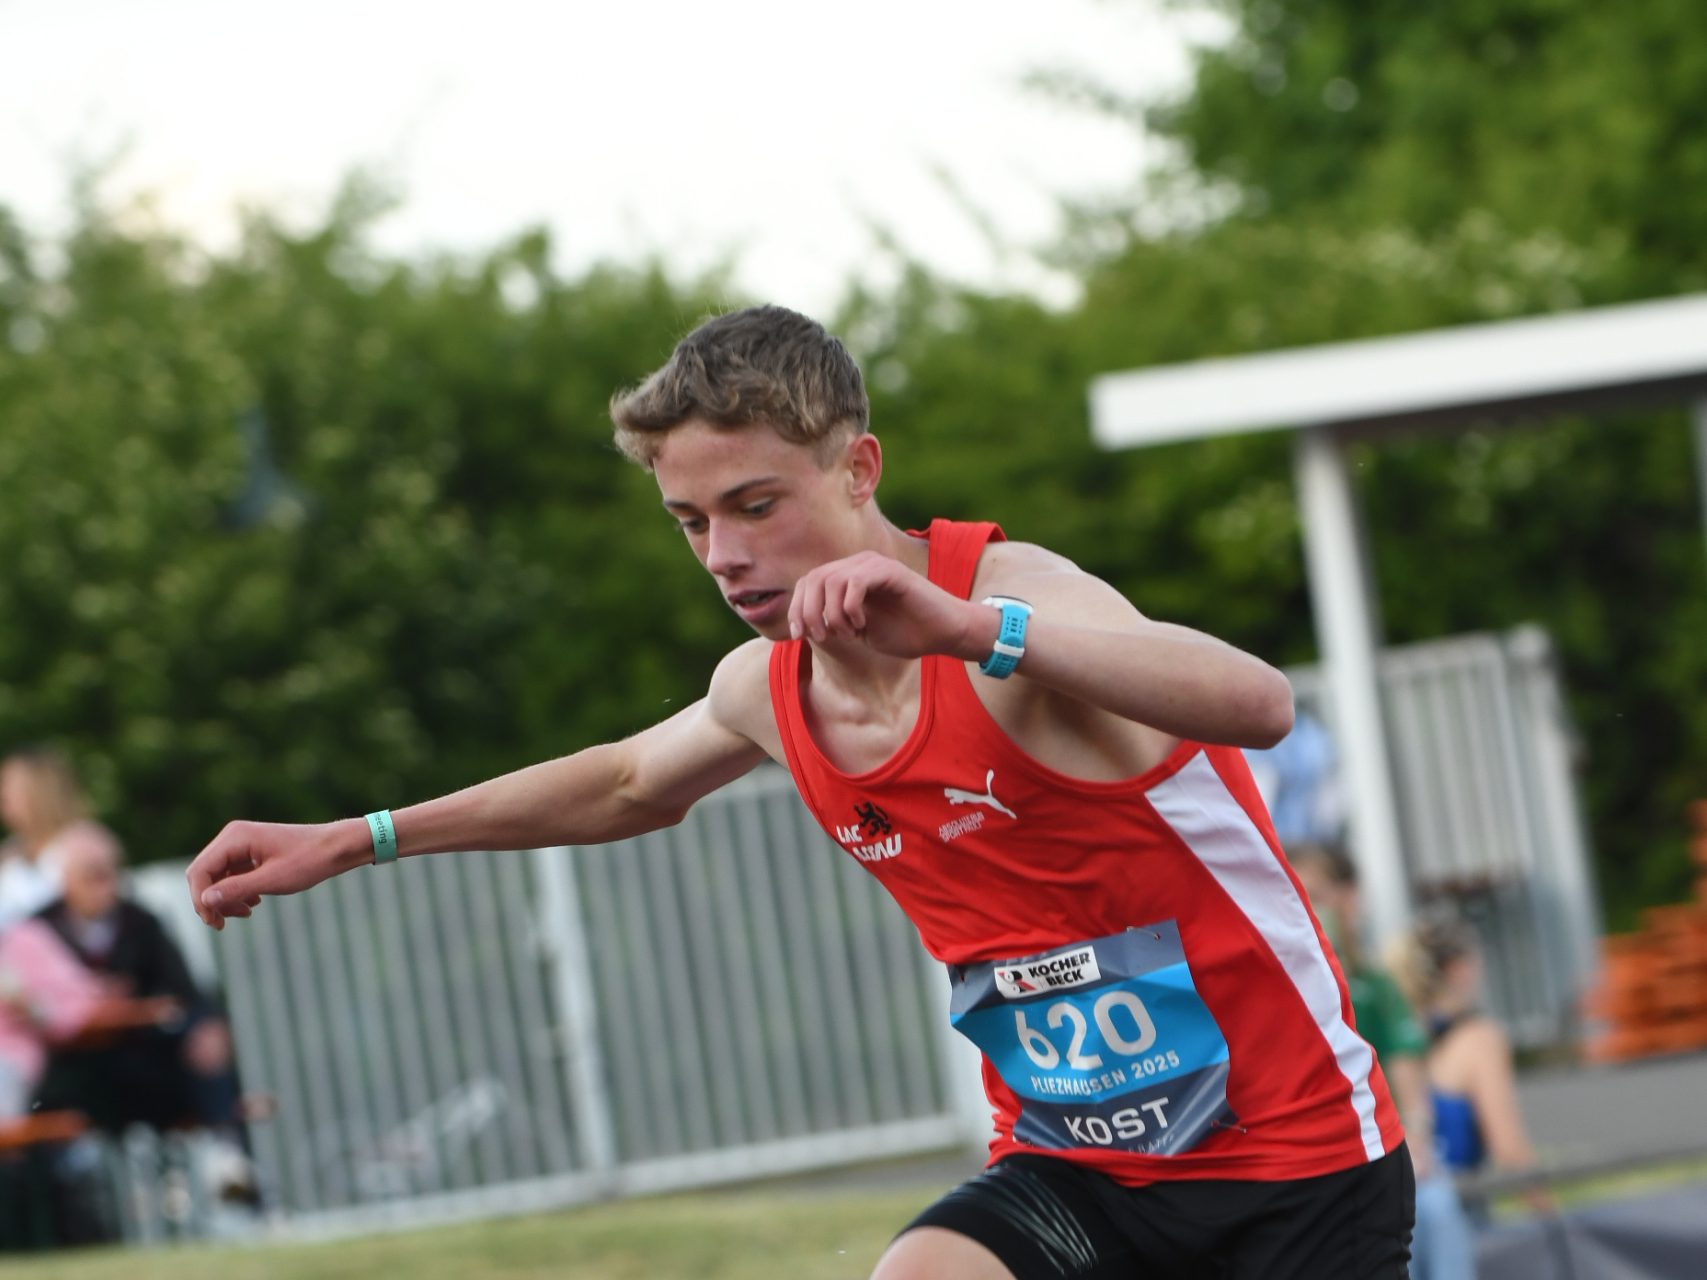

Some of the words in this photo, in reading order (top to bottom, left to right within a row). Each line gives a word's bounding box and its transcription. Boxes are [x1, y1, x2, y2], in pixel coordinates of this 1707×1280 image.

[1028, 952, 1091, 978] KOCHER
[1045, 969, 1085, 986] BECK
[1014, 990, 1157, 1071] 620
[1030, 1069, 1127, 1096] PLIEZHAUSEN
[1131, 1050, 1180, 1079] 2025
[1064, 1097, 1169, 1145] KOST
